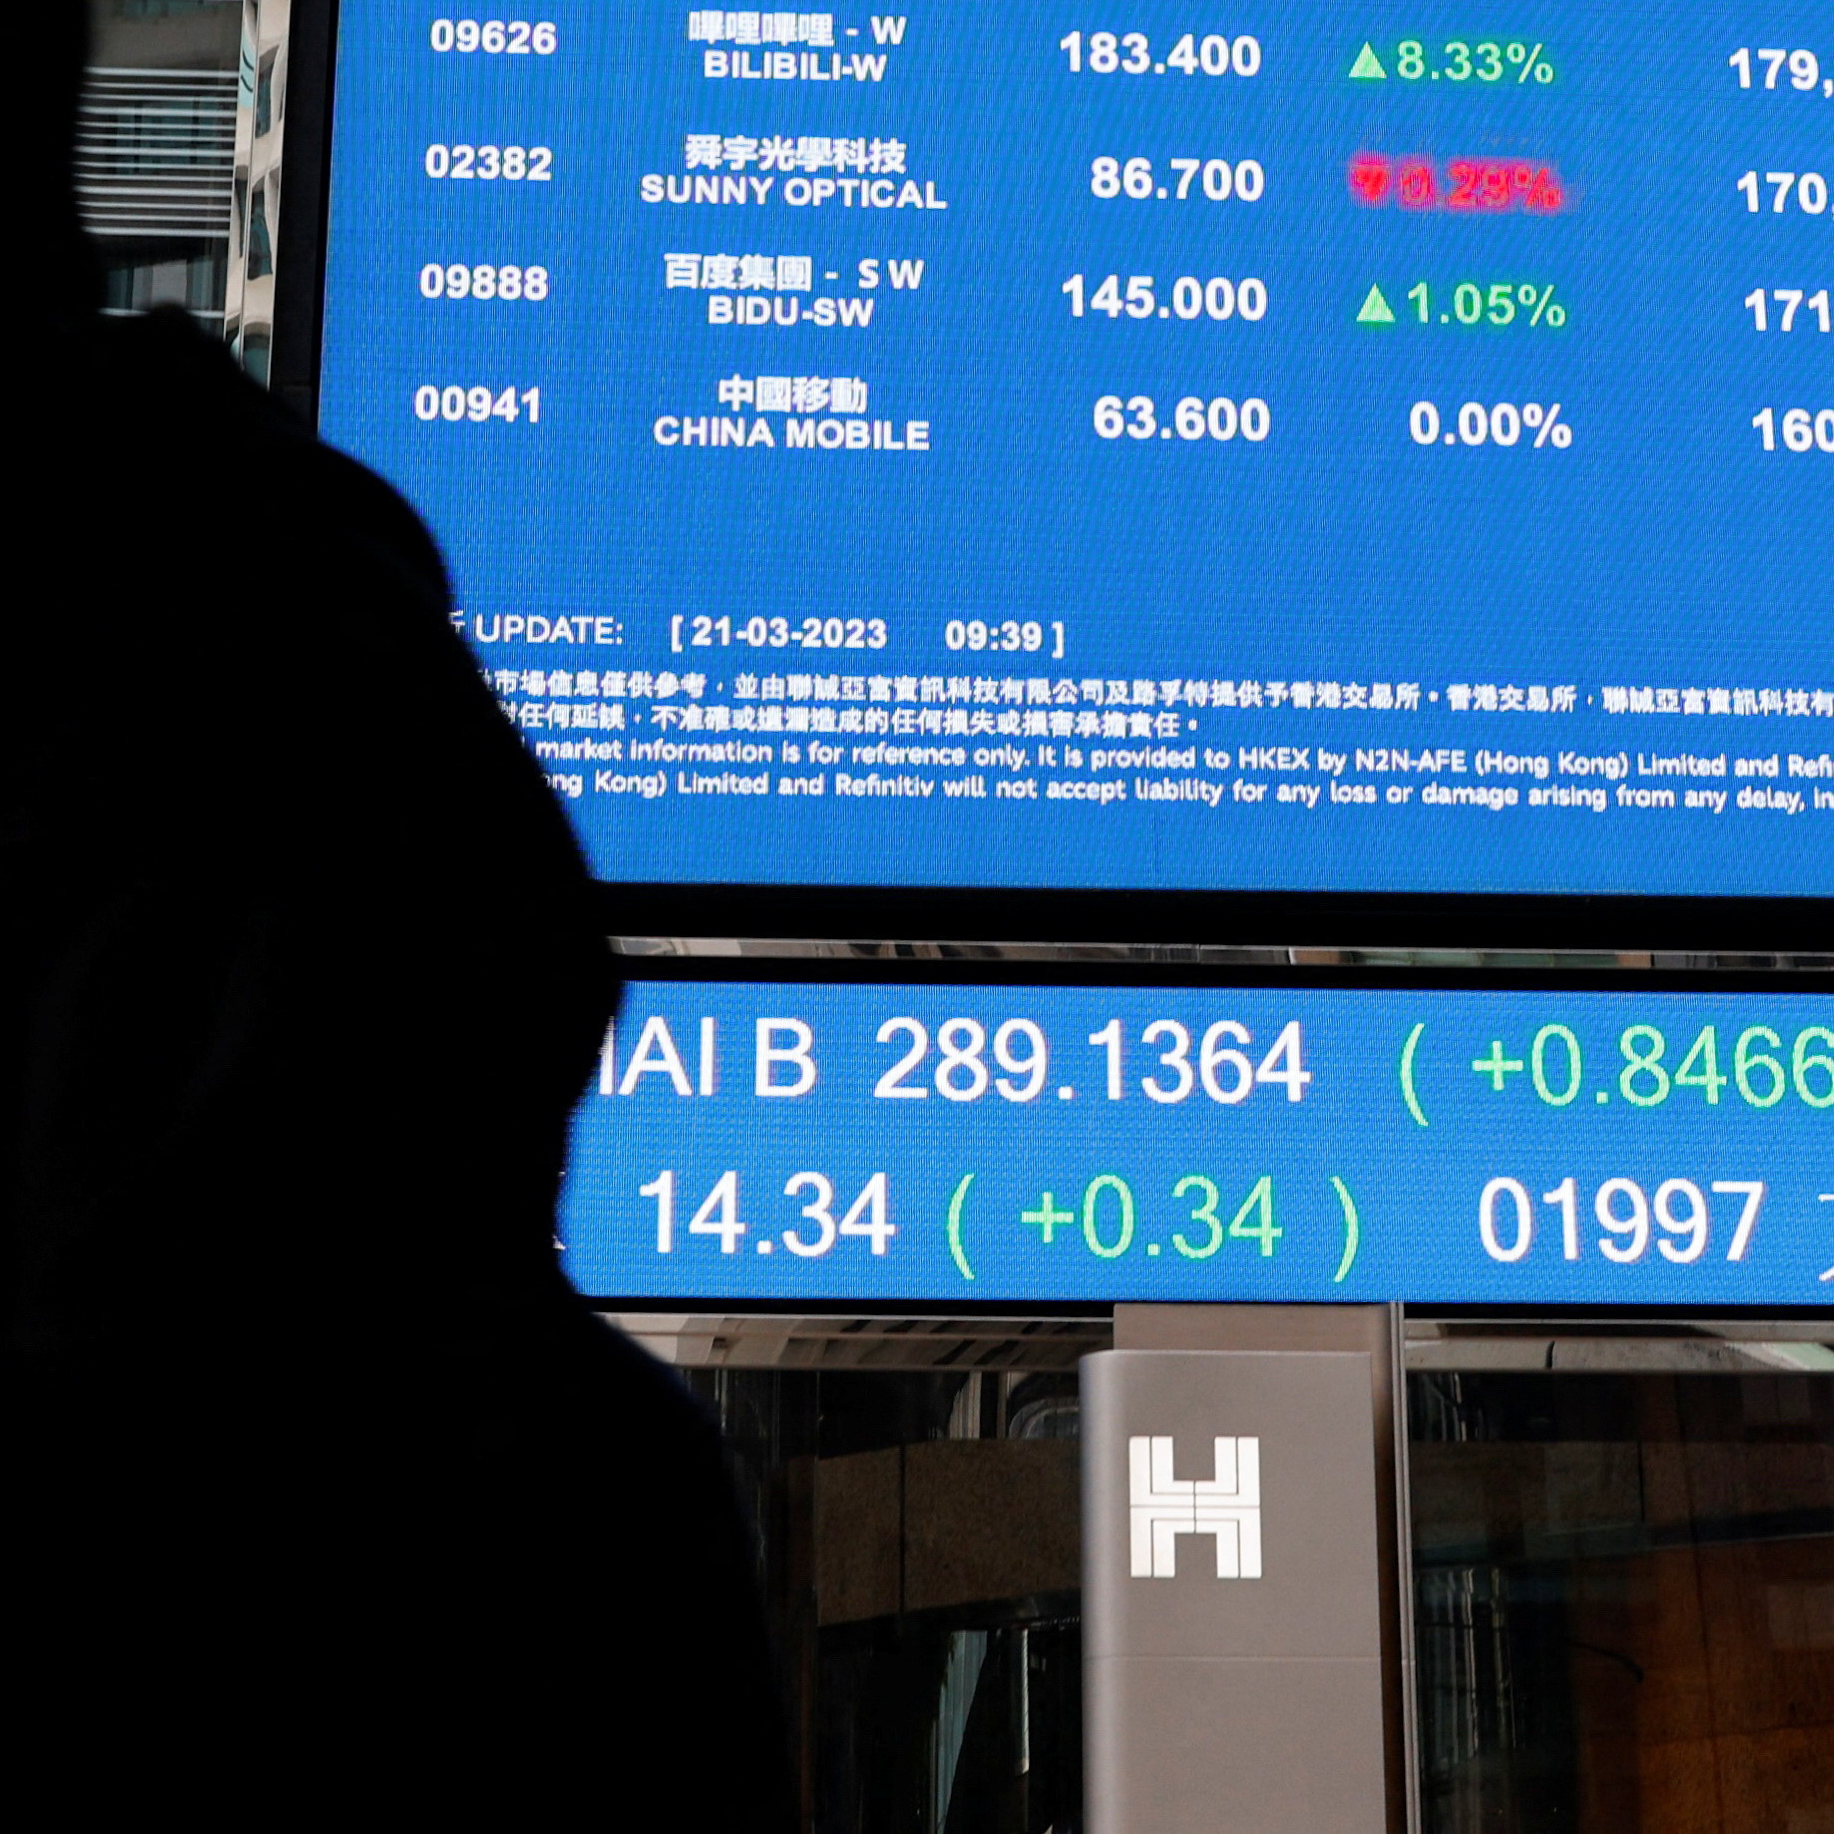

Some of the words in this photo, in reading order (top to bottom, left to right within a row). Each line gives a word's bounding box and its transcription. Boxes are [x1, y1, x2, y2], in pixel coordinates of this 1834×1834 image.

[431, 20, 556, 54] 09626
[872, 17, 906, 44] W
[705, 50, 886, 81] BILIBILI-W
[1061, 32, 1260, 76] 183.400
[1398, 42, 1554, 83] 8.33%
[426, 145, 552, 180] 02382
[686, 135, 906, 173] 舜宇光學科技
[642, 175, 773, 204] SUNNY
[784, 178, 947, 208] OPTICAL
[1092, 157, 1264, 201] 86.700
[420, 264, 548, 300] 09888
[665, 254, 811, 291] 百度集團
[709, 296, 873, 326] BIDU-SW
[1063, 275, 1267, 320] 145.000
[1408, 284, 1566, 326] 1.05%
[415, 386, 539, 422] 00941
[719, 375, 867, 413] 中國移動
[654, 417, 774, 447] CHINA
[786, 419, 929, 450] MOBILE
[1094, 396, 1270, 441] 63.600
[1410, 402, 1572, 448] 0.00%
[476, 615, 622, 644] UPDATE:
[692, 616, 886, 648] 21-03-2023
[946, 621, 1041, 651] 09:39
[536, 738, 622, 759] market
[630, 739, 772, 762] information
[808, 741, 843, 763] for
[853, 742, 966, 765] reference
[974, 745, 1029, 771] only.
[1039, 746, 1056, 766] It
[1091, 747, 1195, 770] provided
[1239, 748, 1309, 769] HKEX
[1318, 749, 1346, 775] by
[1356, 749, 1466, 771] N2N-AFE
[1476, 751, 1549, 778] (Hong
[1559, 753, 1628, 779] Kong)
[1638, 755, 1726, 776] Limited
[1735, 755, 1779, 777] and
[596, 771, 666, 798] Kong)
[678, 773, 768, 794] Limited
[779, 775, 824, 794] and
[836, 774, 934, 796] Refinitiv
[944, 777, 986, 797] will
[997, 779, 1037, 798] not
[1047, 781, 1126, 804] accept
[1136, 778, 1223, 806] liability
[1233, 779, 1266, 802] for
[1277, 785, 1320, 808] any
[1331, 781, 1376, 803] loss
[1387, 786, 1412, 803] or
[1423, 783, 1518, 810] damage
[1529, 786, 1606, 811] arising
[1617, 785, 1674, 806] from
[1685, 791, 1726, 813] any
[1737, 787, 1804, 813] delay,
[756, 1018, 817, 1097] B
[874, 1017, 1311, 1104] 289.1364
[640, 1170, 897, 1257] 14.34
[1023, 1176, 1281, 1257] +0.34
[1479, 1177, 1764, 1263] 01997
